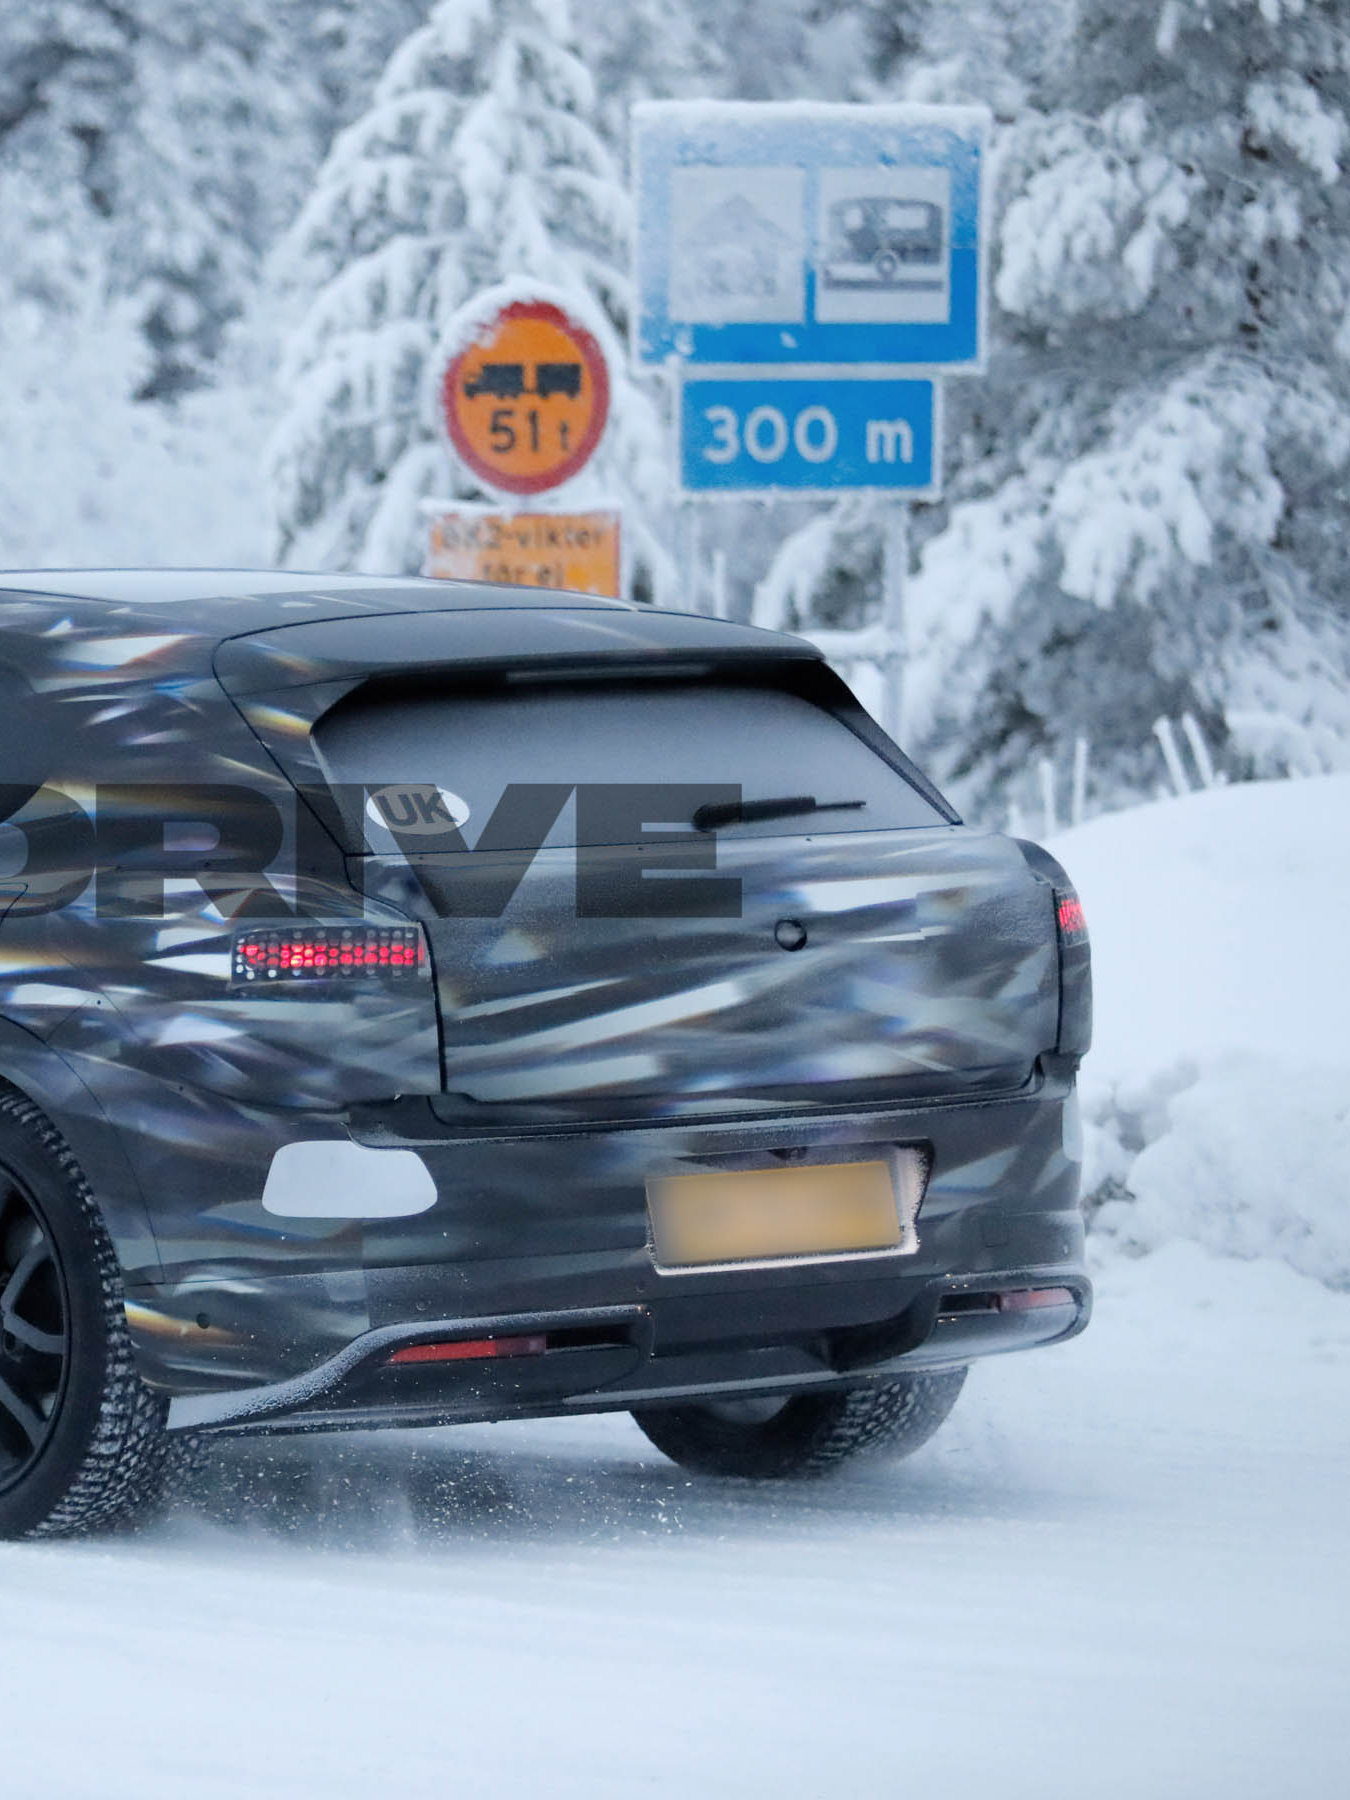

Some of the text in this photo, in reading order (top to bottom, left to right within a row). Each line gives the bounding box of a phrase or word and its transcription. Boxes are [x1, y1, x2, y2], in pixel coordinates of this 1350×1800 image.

[488, 409, 570, 453] 51 t
[701, 404, 914, 464] 300 m
[376, 791, 459, 826] UK
